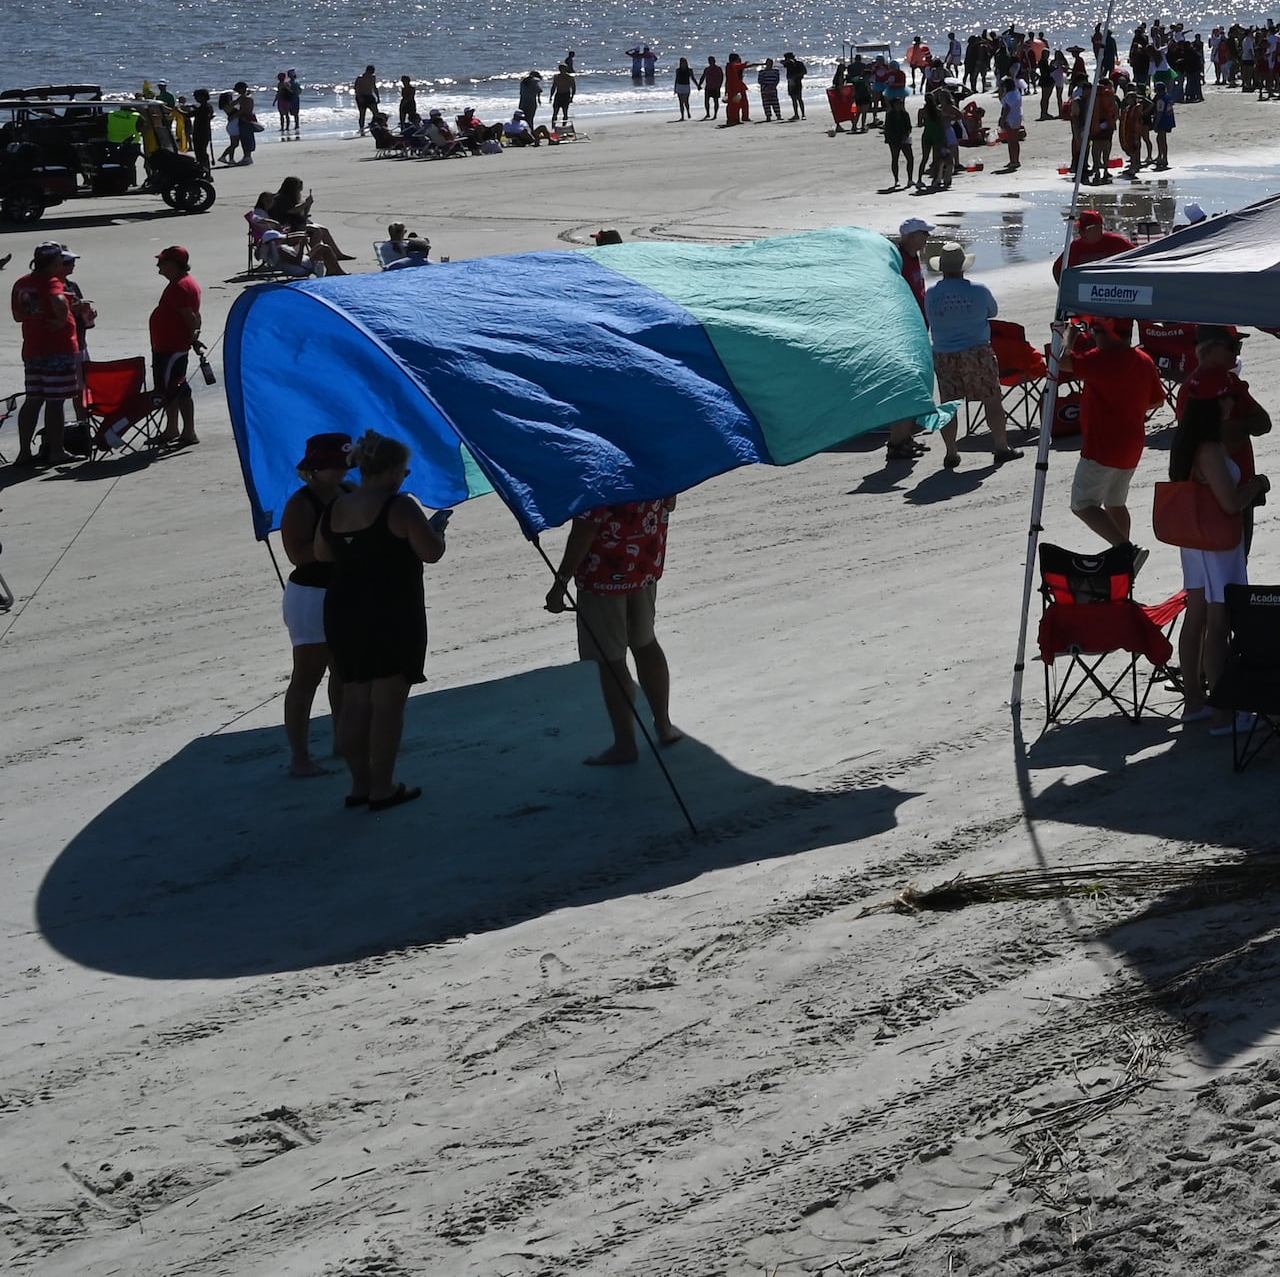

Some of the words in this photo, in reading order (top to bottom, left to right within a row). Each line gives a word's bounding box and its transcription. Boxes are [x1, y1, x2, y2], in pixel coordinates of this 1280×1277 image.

[1090, 285, 1138, 302] Academy
[1145, 328, 1184, 337] GEORGIA
[593, 582, 638, 591] GEORGIA
